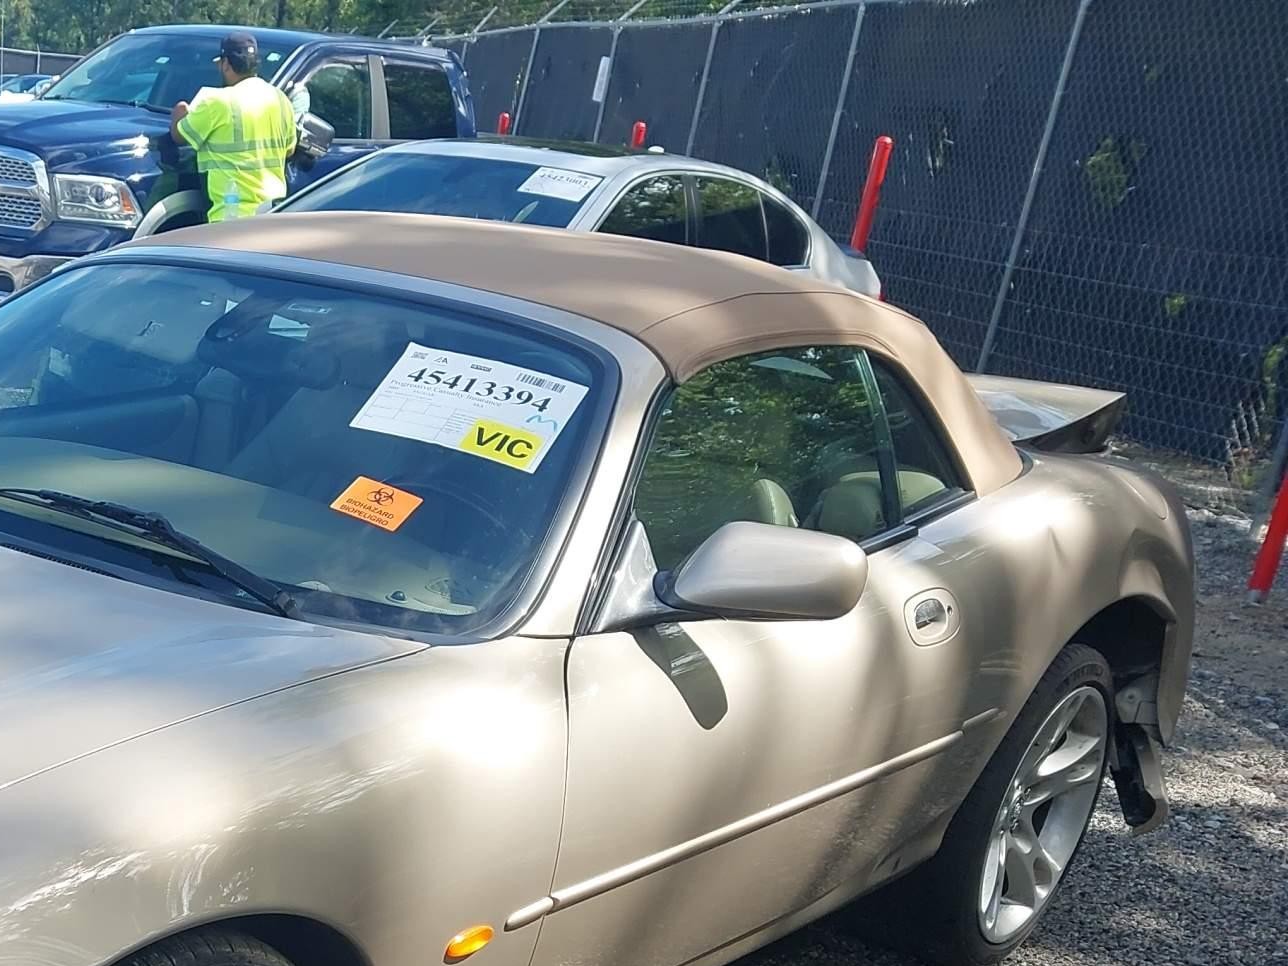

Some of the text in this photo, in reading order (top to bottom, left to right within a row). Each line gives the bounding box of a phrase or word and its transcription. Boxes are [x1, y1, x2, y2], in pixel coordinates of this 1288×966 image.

[407, 367, 552, 413] 45413394
[433, 386, 465, 400] Casualty
[466, 393, 503, 407] Insurance
[476, 426, 533, 459] VIC
[339, 503, 390, 526] BIOPELIGRO
[346, 498, 395, 520] BIOHAZARD
